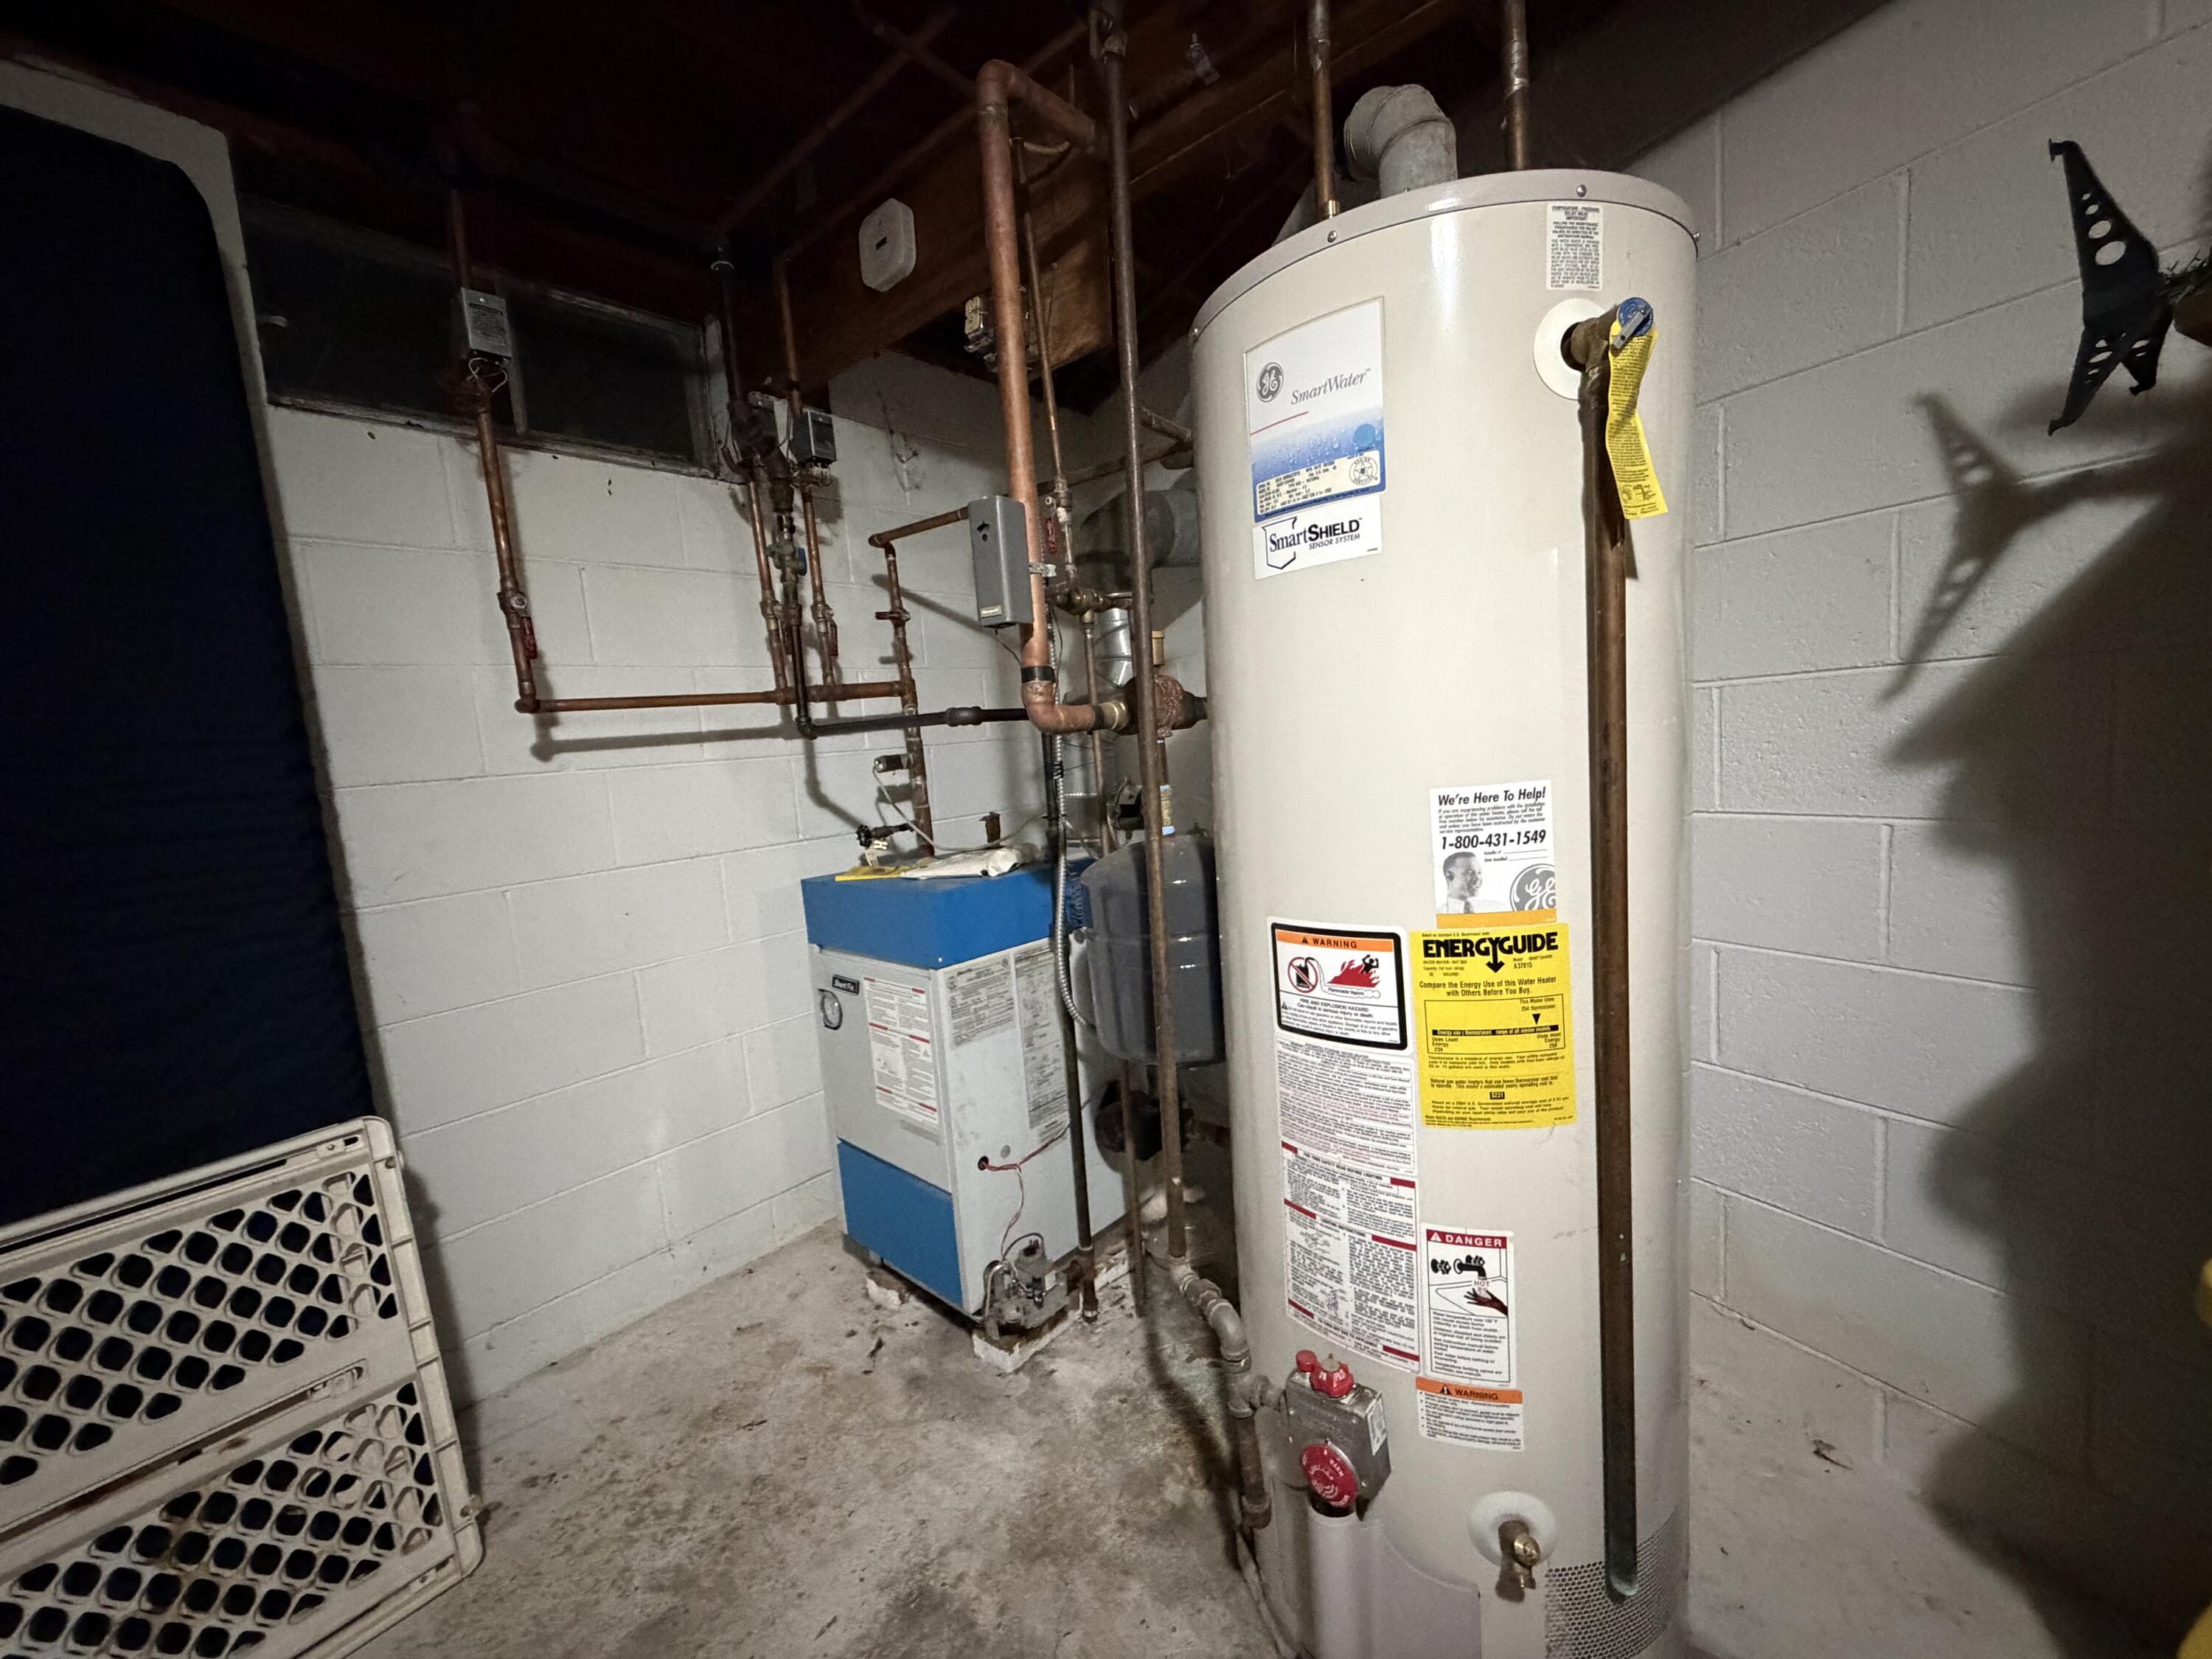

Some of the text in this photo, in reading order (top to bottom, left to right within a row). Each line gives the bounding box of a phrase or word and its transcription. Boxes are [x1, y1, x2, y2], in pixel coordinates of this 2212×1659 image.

[1290, 373, 1366, 405] SmartWater
[1309, 533, 1360, 550] SENSOR SYSTEM
[1439, 786, 1545, 806] We're Here To Help!
[1441, 830, 1546, 850] 1-800-431-1549
[1312, 938, 1357, 948] WARNING
[1422, 931, 1559, 958] ENERGYGUIDE
[1419, 981, 1446, 990] Compare
[1460, 981, 1481, 990] Energy
[1445, 1234, 1502, 1248] DANGER
[1455, 1388, 1498, 1400] WARNING
